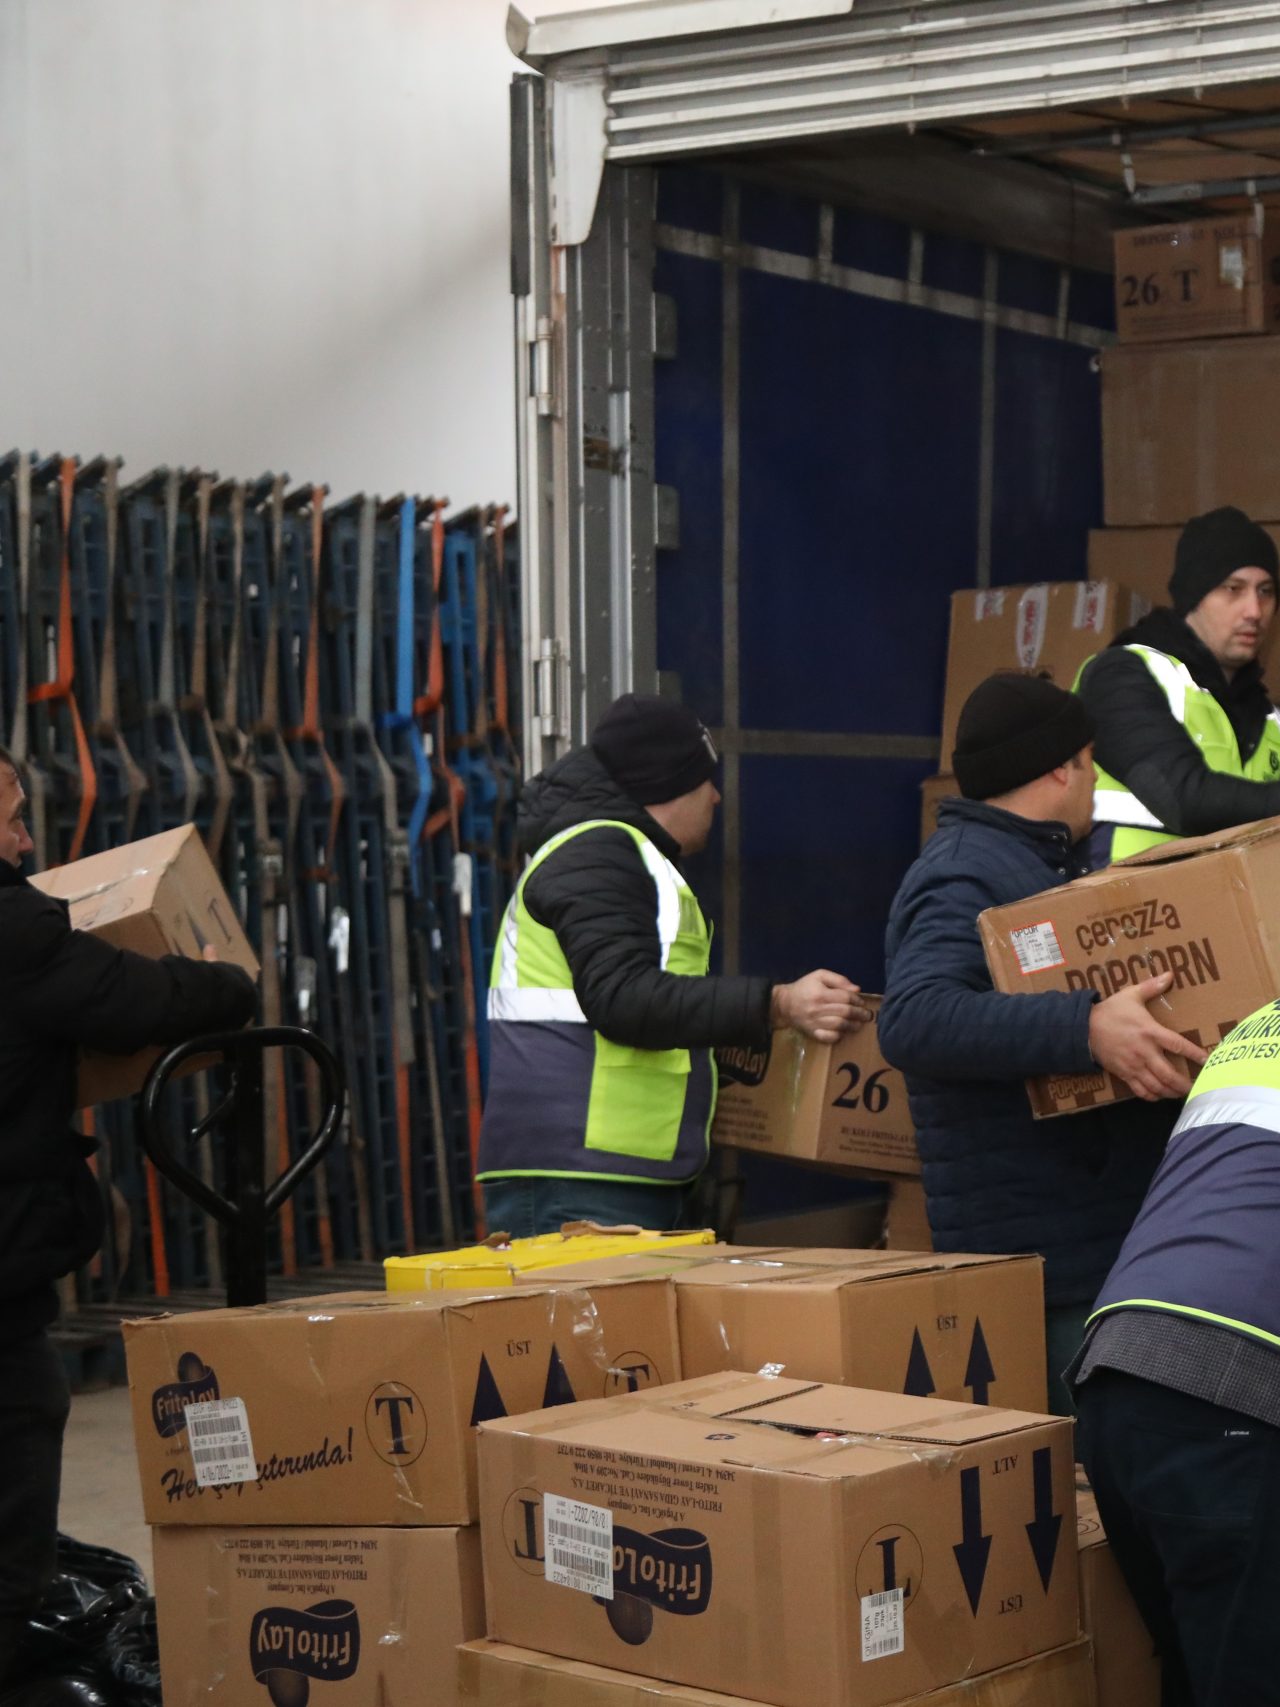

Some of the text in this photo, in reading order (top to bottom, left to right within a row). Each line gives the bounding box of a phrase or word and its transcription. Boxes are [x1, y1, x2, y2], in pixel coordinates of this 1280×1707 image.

[1121, 272, 1160, 307] 26
[832, 1062, 893, 1113] 26
[1047, 1074, 1106, 1099] POPCORN
[506, 1340, 532, 1357] ÜST
[374, 1396, 413, 1454] T
[992, 1455, 1018, 1475] ALT
[680, 1496, 722, 1512] FRITO-LAY
[612, 1545, 701, 1601] FritoLa
[998, 1594, 1023, 1614] ÜST
